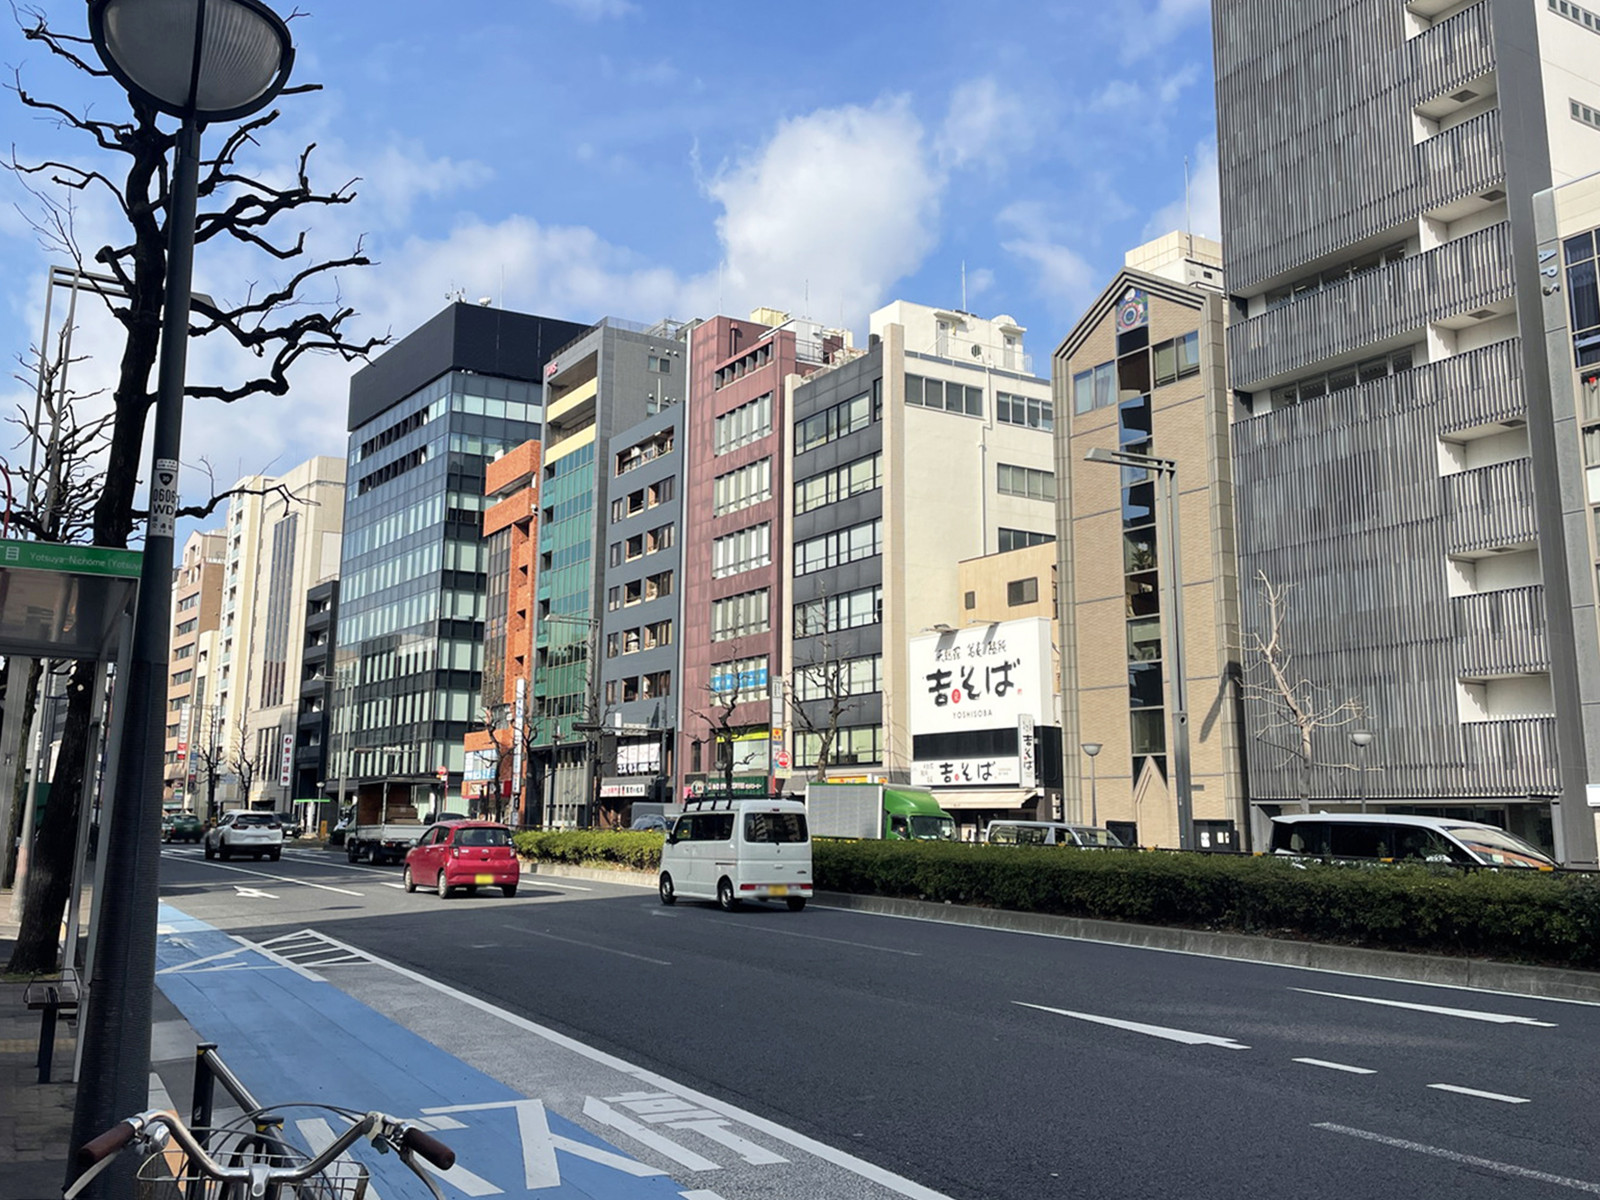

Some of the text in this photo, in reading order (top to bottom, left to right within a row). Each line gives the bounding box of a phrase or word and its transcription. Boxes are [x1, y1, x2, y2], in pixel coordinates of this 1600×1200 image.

[153, 503, 174, 515] WD
[0, 545, 19, 560] 目
[29, 552, 105, 567] Yotsuya-Nichome
[926, 658, 1021, 707] 吉そば
[953, 709, 993, 719] YOSHISOBA
[1023, 734, 1033, 770] 吉そば
[939, 761, 996, 783] 吉そば
